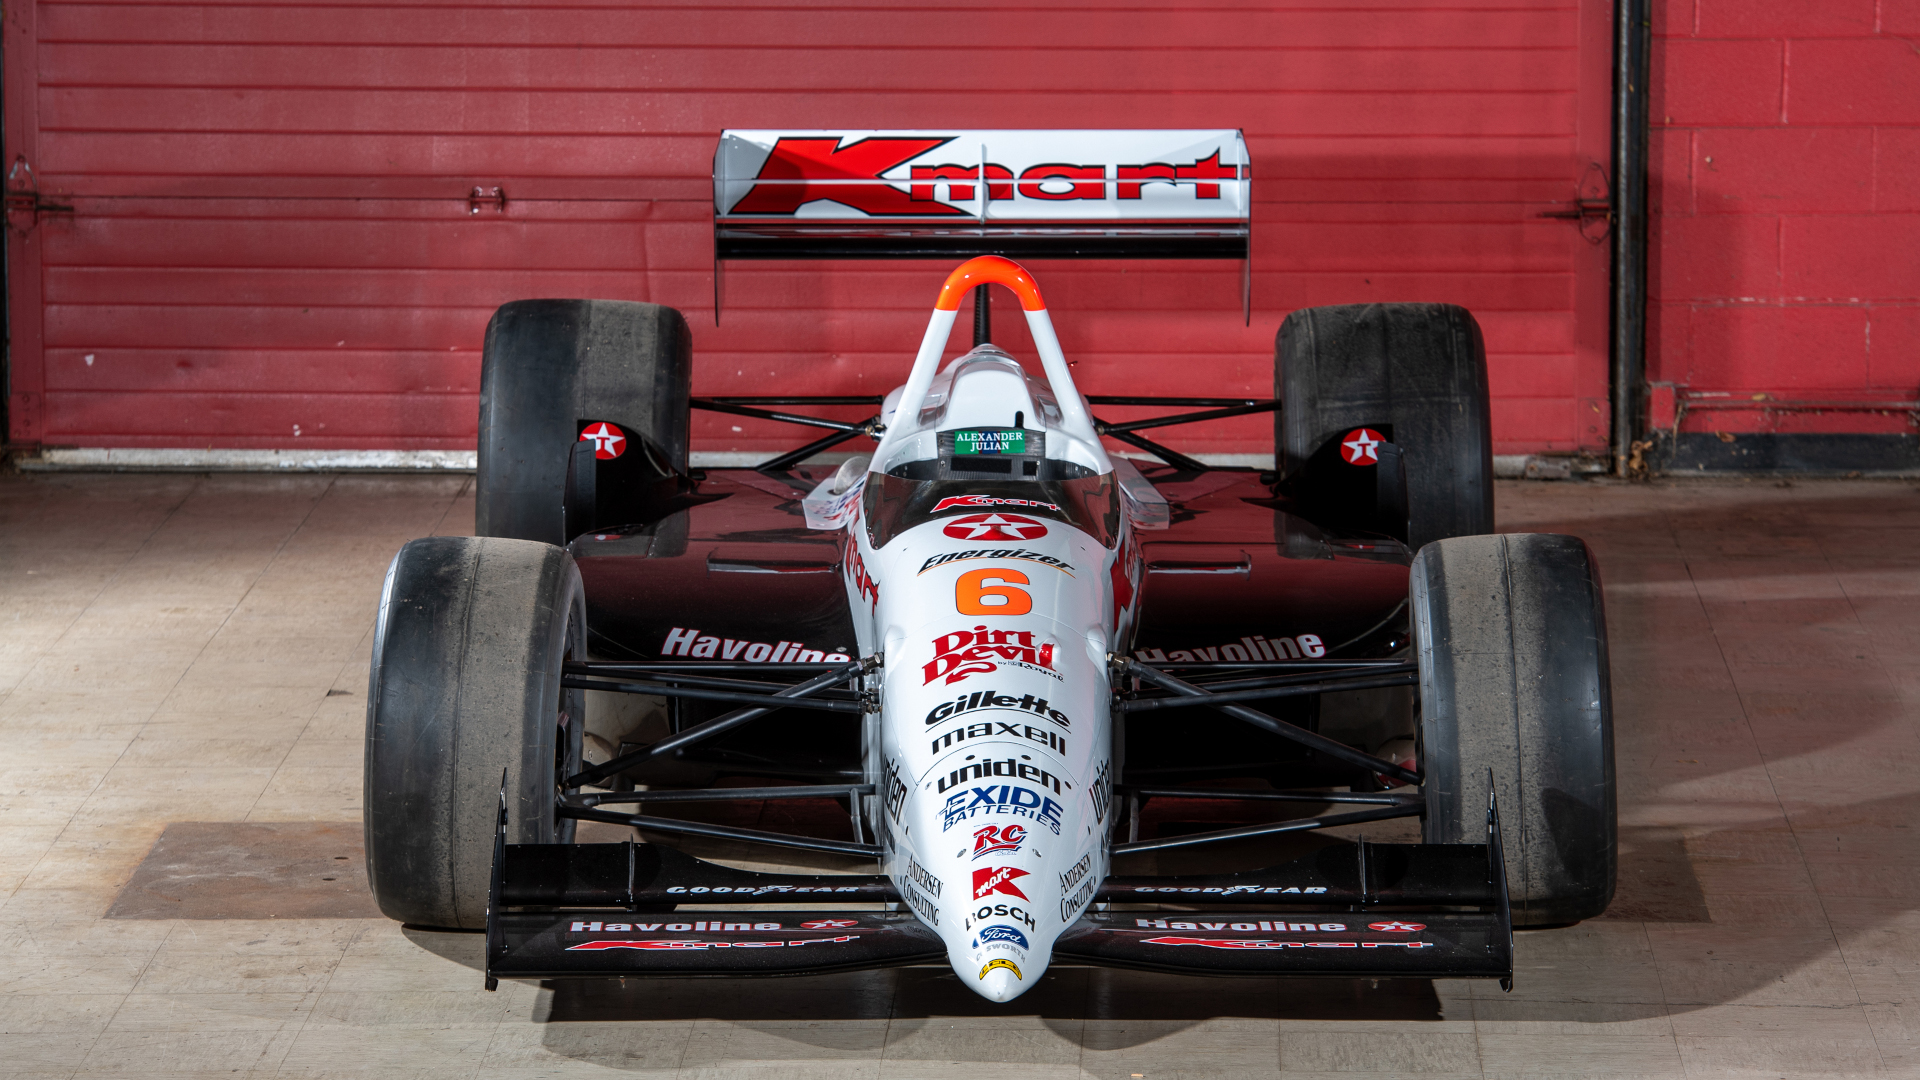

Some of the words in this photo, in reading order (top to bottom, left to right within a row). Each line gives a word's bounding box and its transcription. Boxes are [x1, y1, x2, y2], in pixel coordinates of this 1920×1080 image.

[728, 136, 1238, 216] Kmart
[956, 431, 1023, 442] ALEXANDER
[970, 441, 1010, 452] JULIAN
[930, 494, 1062, 514] Kmart
[918, 548, 1076, 574] Energizer
[955, 567, 1033, 616] 6
[932, 625, 1037, 660] Dirt
[922, 644, 1057, 687] Devil
[925, 690, 1071, 728] Gillette
[931, 721, 1066, 756] maxell
[938, 757, 1061, 797] uniden
[940, 784, 1064, 828] EXIDE
[943, 804, 1061, 836] BATTERIES
[972, 824, 1028, 856] RC
[906, 851, 944, 900] ANDERSEN
[1058, 851, 1092, 897] ANDERSEN
[903, 874, 940, 927] CONSULTING
[1060, 875, 1095, 923] CONSULTING
[570, 920, 783, 933] Havoline
[980, 926, 1022, 943] Ford
[1135, 918, 1348, 932] Havoline
[564, 934, 861, 951] Kmart
[976, 943, 1027, 964] CSWORTH
[1139, 936, 1434, 950] Kmart
